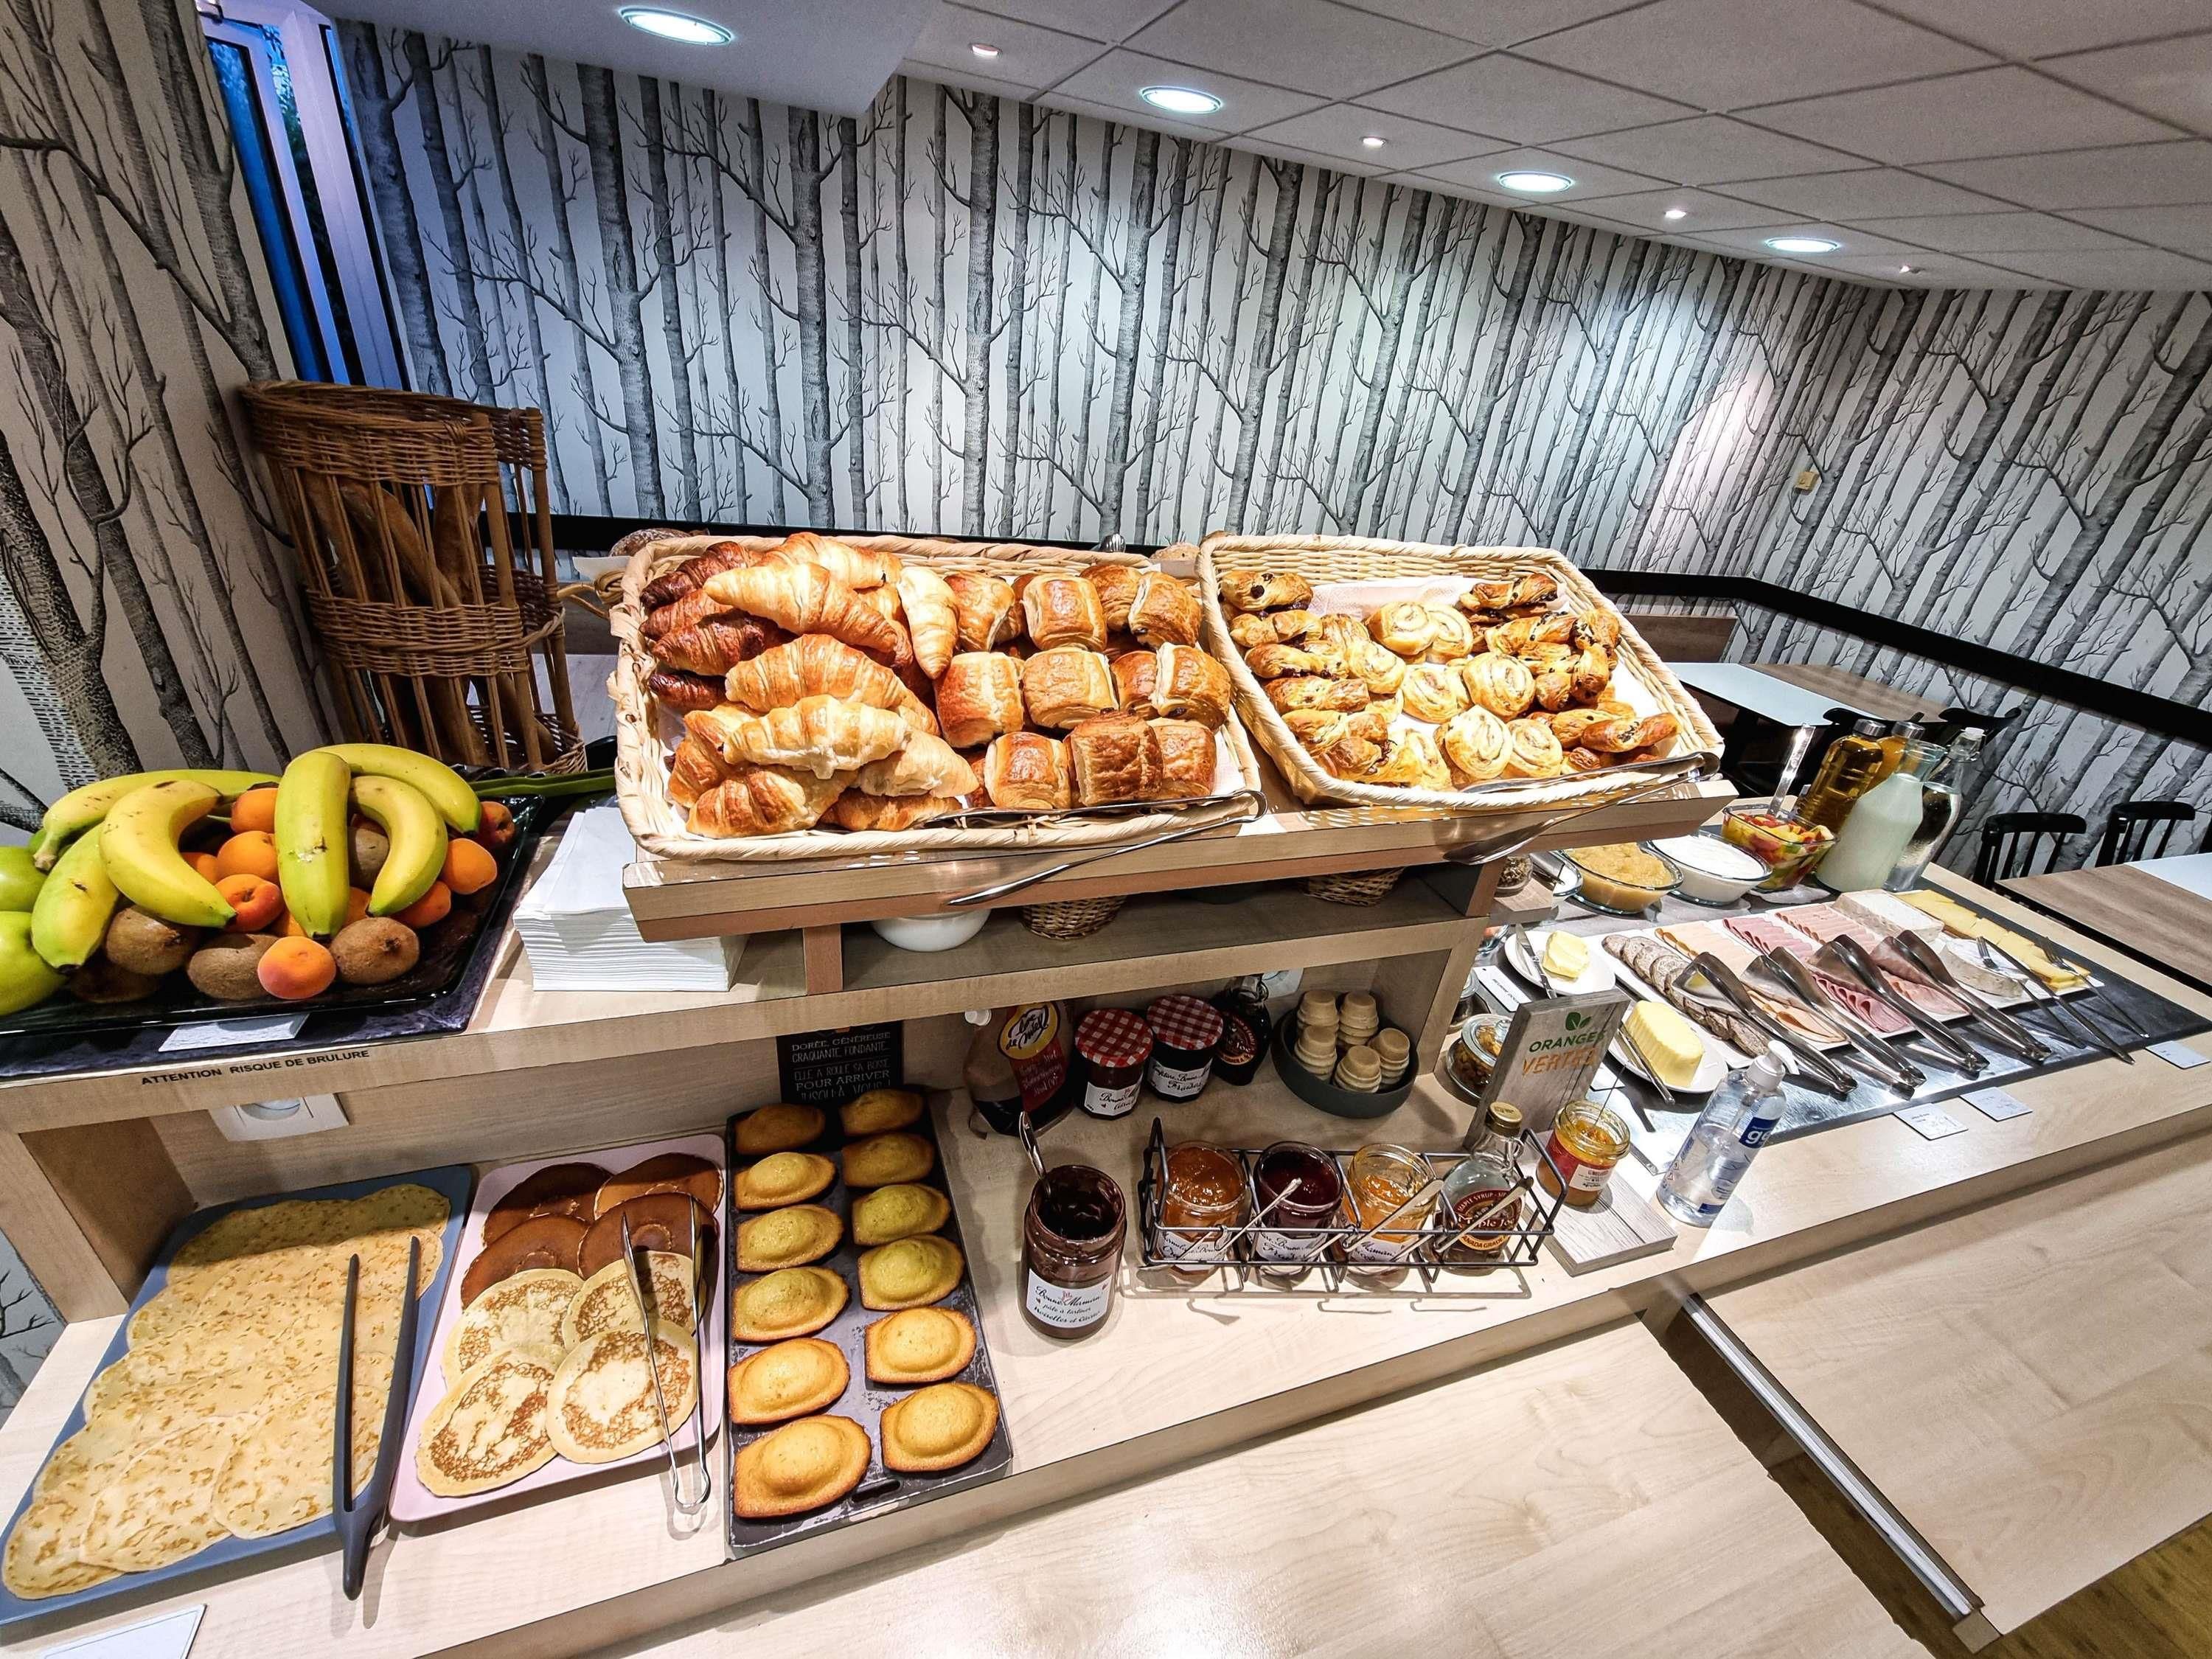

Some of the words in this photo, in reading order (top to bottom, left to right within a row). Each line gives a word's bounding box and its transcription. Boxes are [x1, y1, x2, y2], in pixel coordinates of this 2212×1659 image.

[1528, 1031, 1605, 1053] ORANGES
[142, 1068, 223, 1085] ATTENTION
[229, 1060, 282, 1075] RISQUE
[285, 1058, 303, 1068] DE
[306, 1049, 370, 1065] BRULURE
[796, 1078, 832, 1091] POUR
[836, 1069, 890, 1085] ARRIVER
[1457, 1197, 1473, 1213] MAPLE
[1475, 1192, 1494, 1201] SYRUP
[1034, 1286, 1062, 1306] Bonne
[1063, 1295, 1101, 1307] Maman
